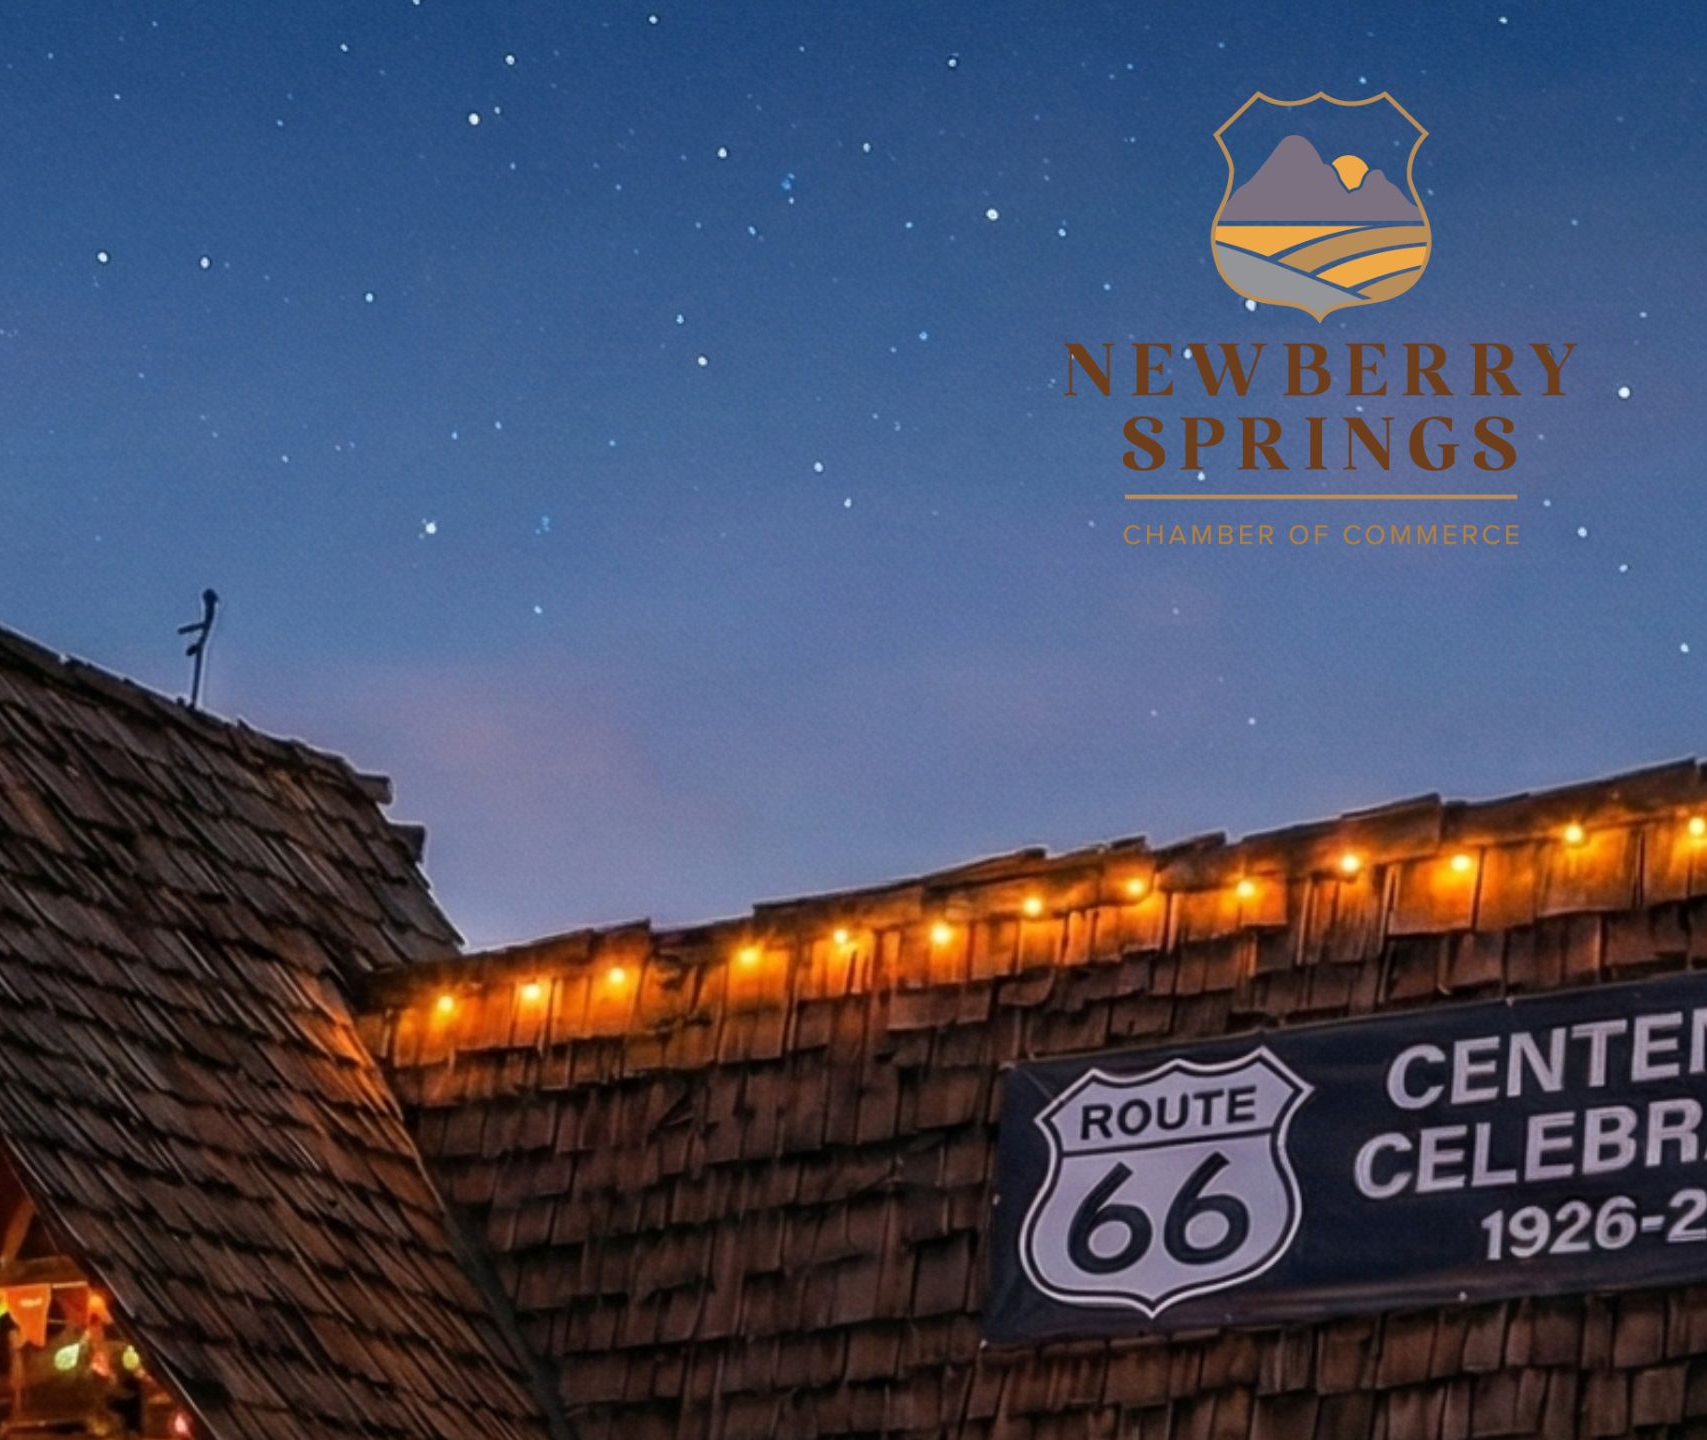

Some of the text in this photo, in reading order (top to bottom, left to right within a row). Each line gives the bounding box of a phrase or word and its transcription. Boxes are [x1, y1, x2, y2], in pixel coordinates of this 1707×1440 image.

[1387, 1008, 1707, 1110] CENTE
[1080, 1086, 1257, 1141] ROUTE
[1354, 1097, 1707, 1200] CELEBR
[1065, 1151, 1250, 1274] 66
[1481, 1189, 1707, 1261] 1926-2
